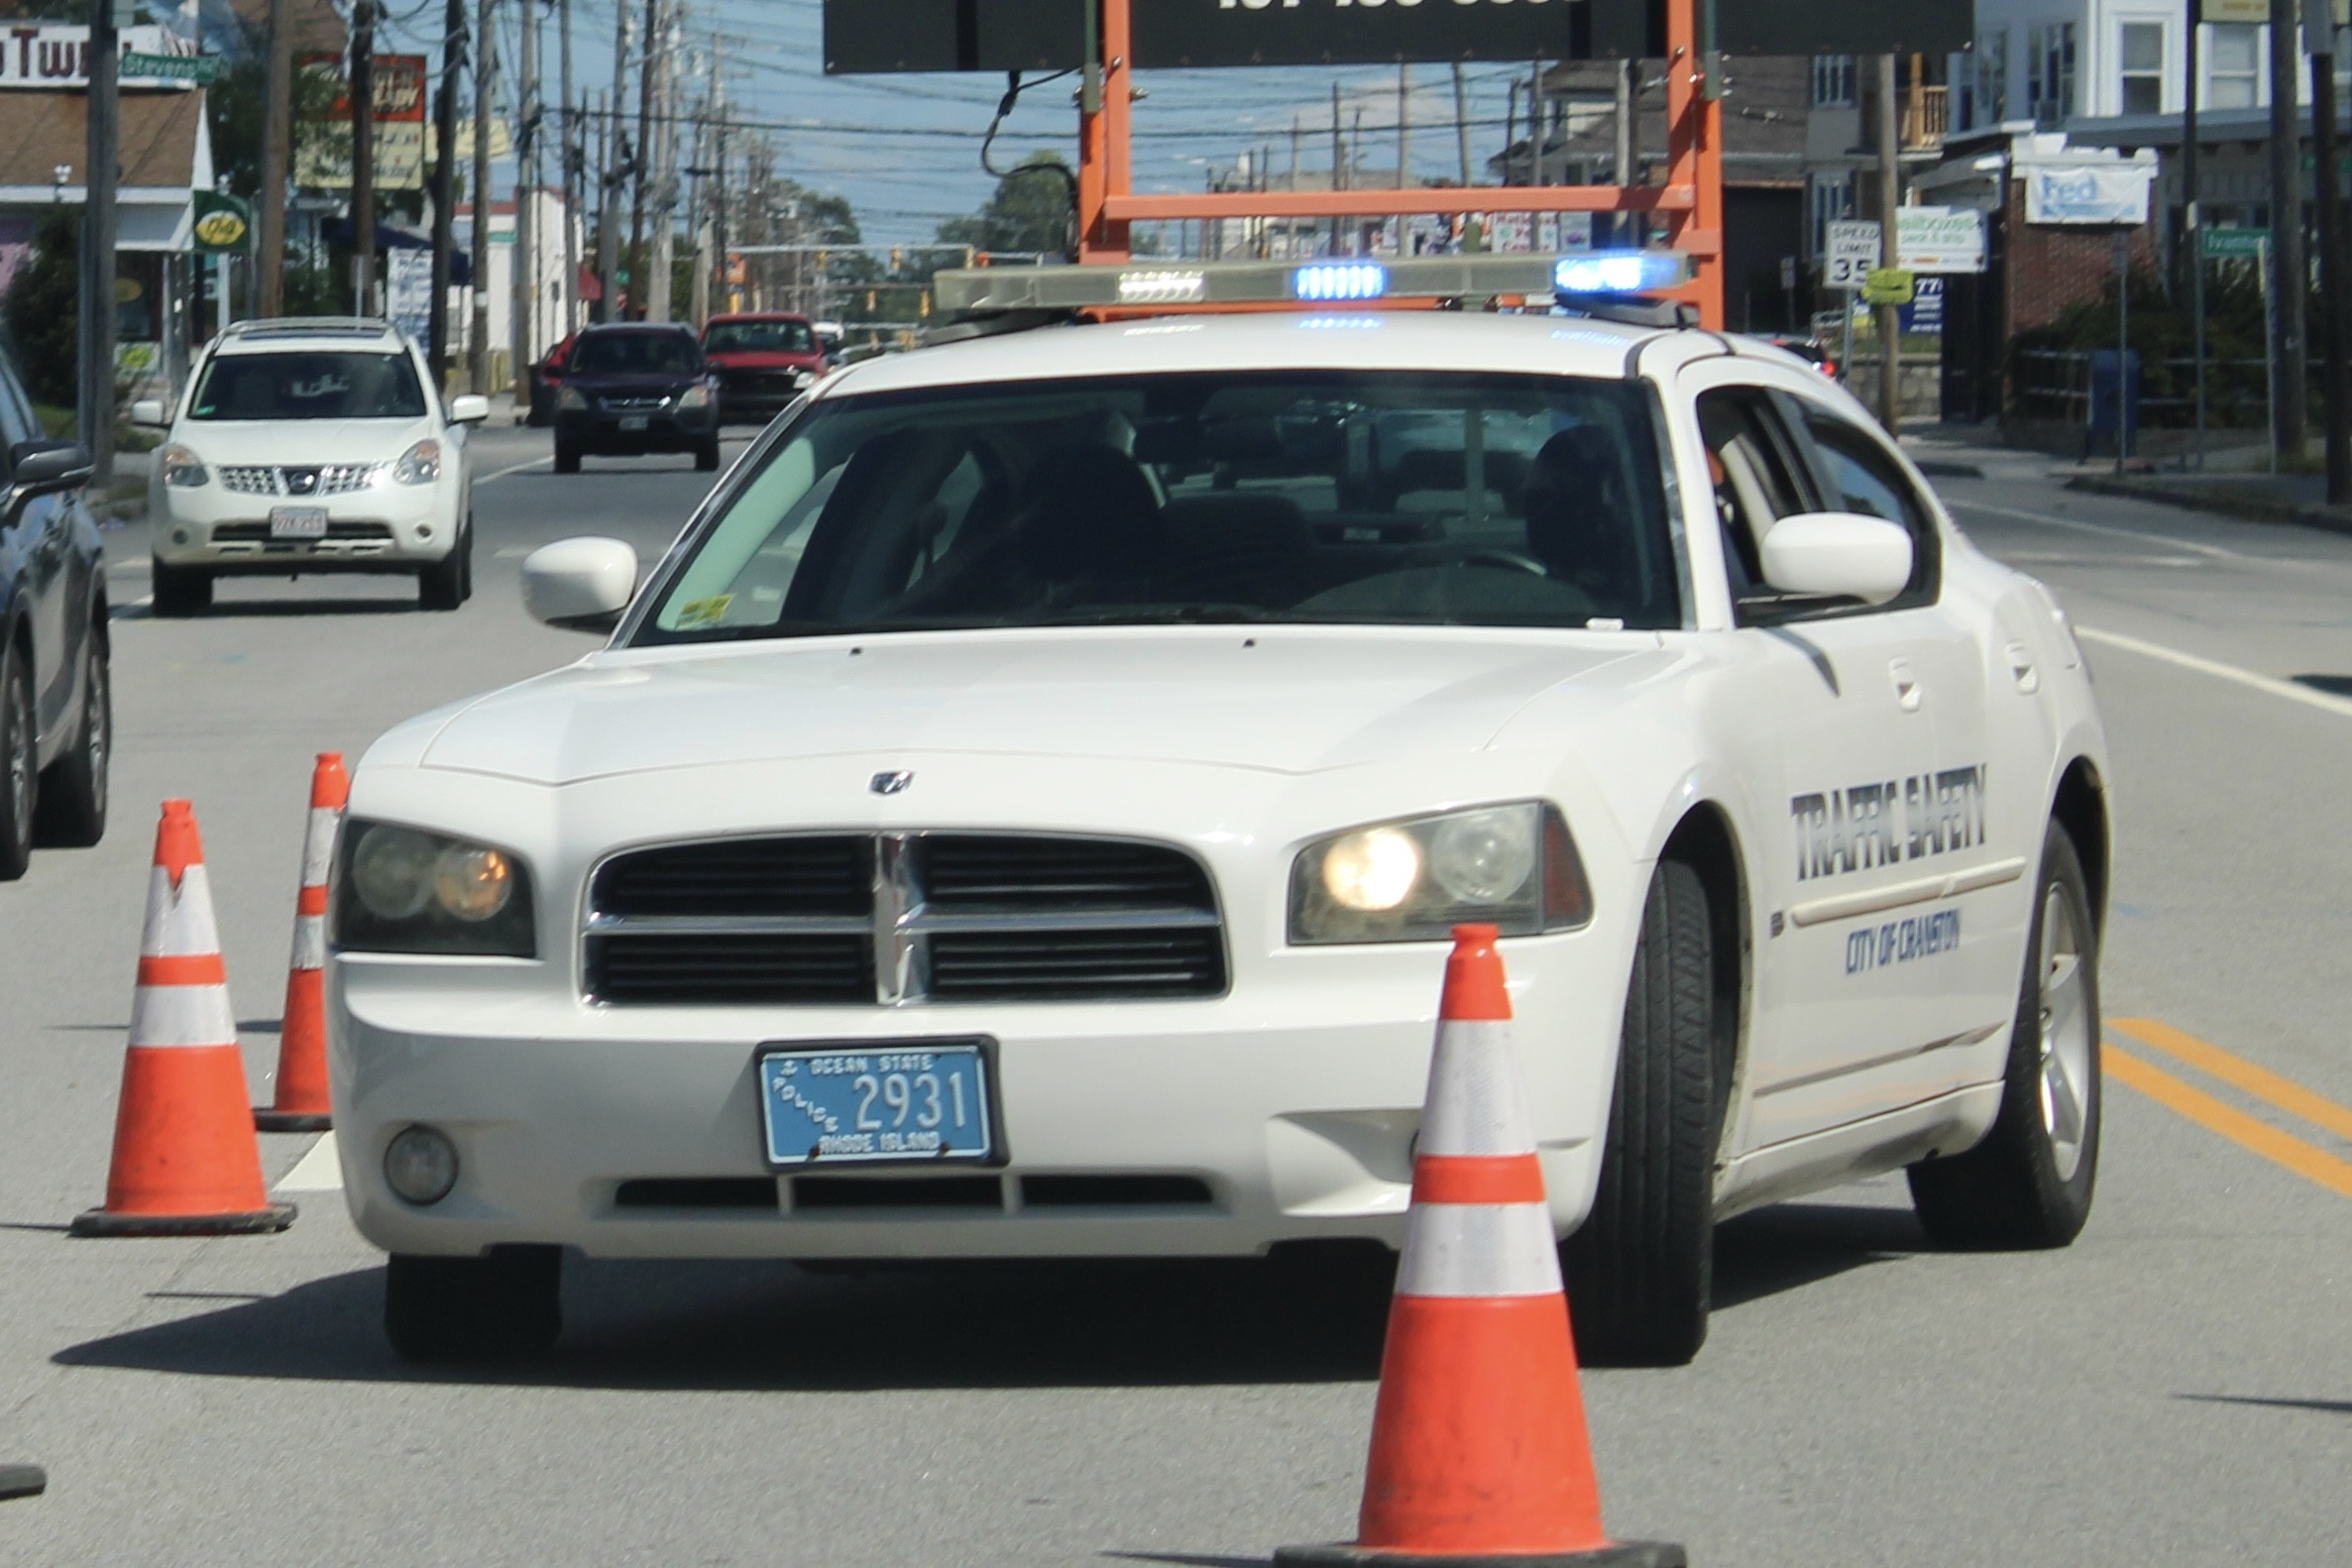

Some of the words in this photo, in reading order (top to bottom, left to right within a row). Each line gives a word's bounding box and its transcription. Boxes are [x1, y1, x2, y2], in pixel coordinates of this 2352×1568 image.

[122, 54, 198, 77] Stevens
[1833, 225, 1880, 241] SPEED
[1836, 243, 1872, 256] LIMIT
[1834, 258, 1872, 282] 35
[1791, 780, 1900, 882] TRAFFIC
[1905, 762, 1987, 860] SAFETY
[1847, 928, 1874, 975] CITY
[1877, 919, 1898, 968] OF
[1898, 907, 1961, 963] CRANSTON
[810, 1057, 868, 1076] OCEAN
[877, 1054, 935, 1073] STATE
[772, 1076, 840, 1133] POLICE
[852, 1071, 965, 1132] 2931
[818, 1133, 874, 1155] RHODE
[879, 1130, 941, 1153] ISLAND
